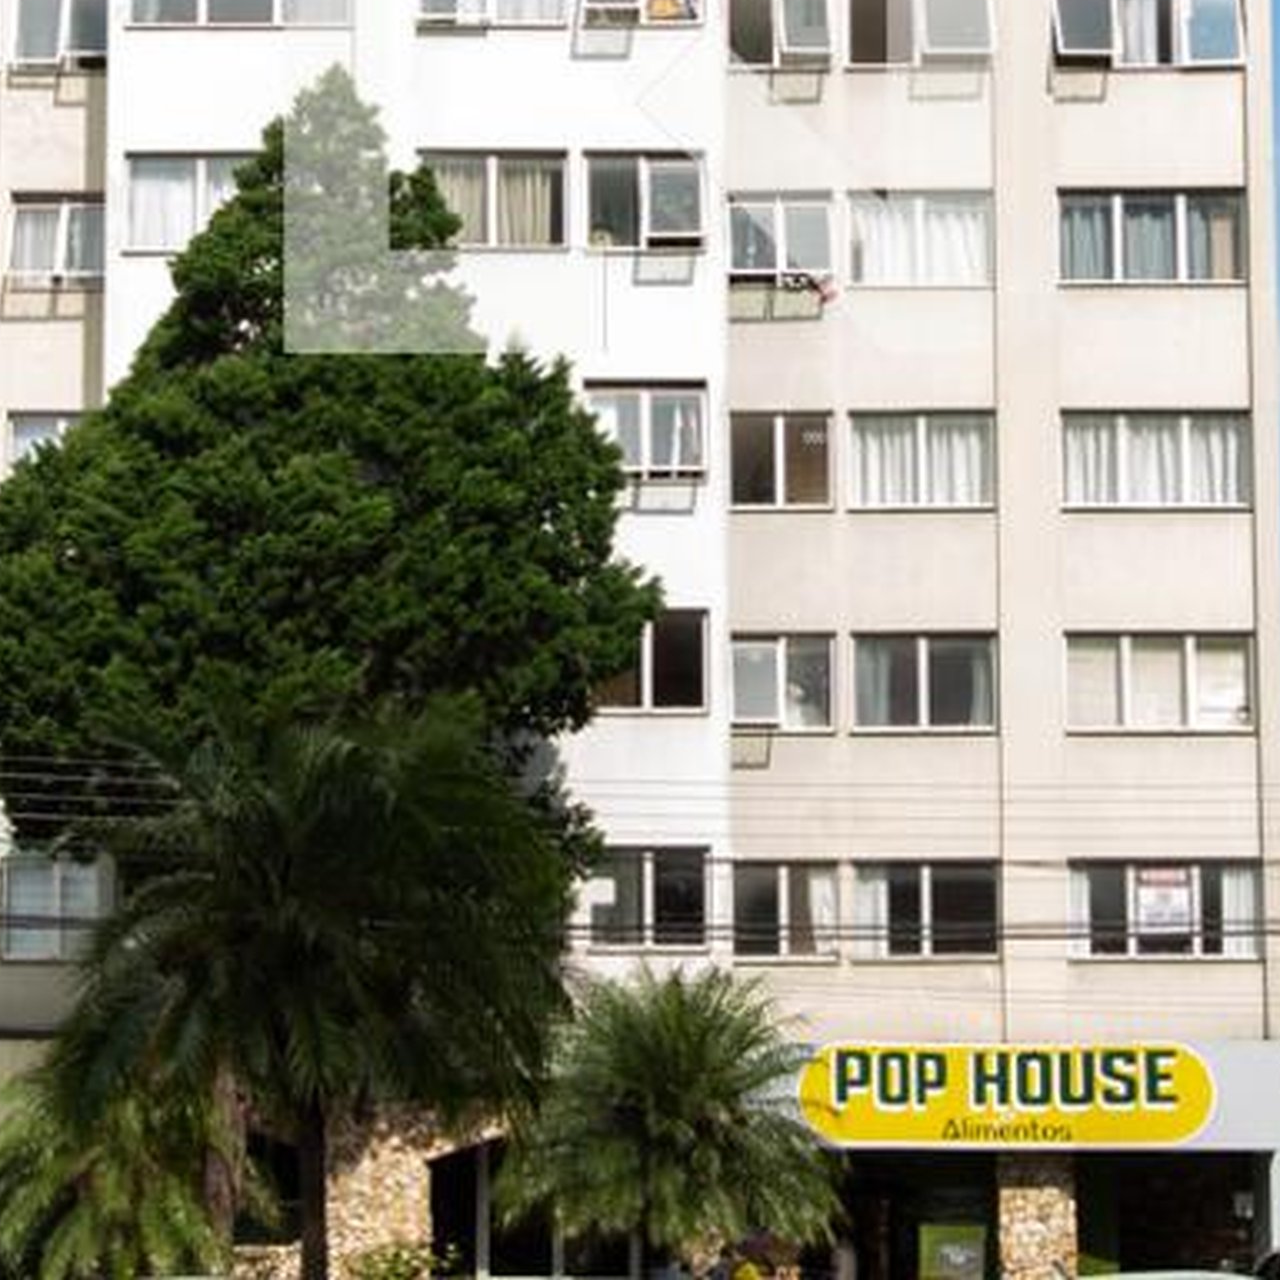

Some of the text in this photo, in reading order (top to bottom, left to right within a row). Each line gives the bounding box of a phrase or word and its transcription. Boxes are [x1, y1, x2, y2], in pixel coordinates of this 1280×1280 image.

[834, 1048, 1177, 1106] POP HOUSE
[941, 1118, 1072, 1143] Alimentos
